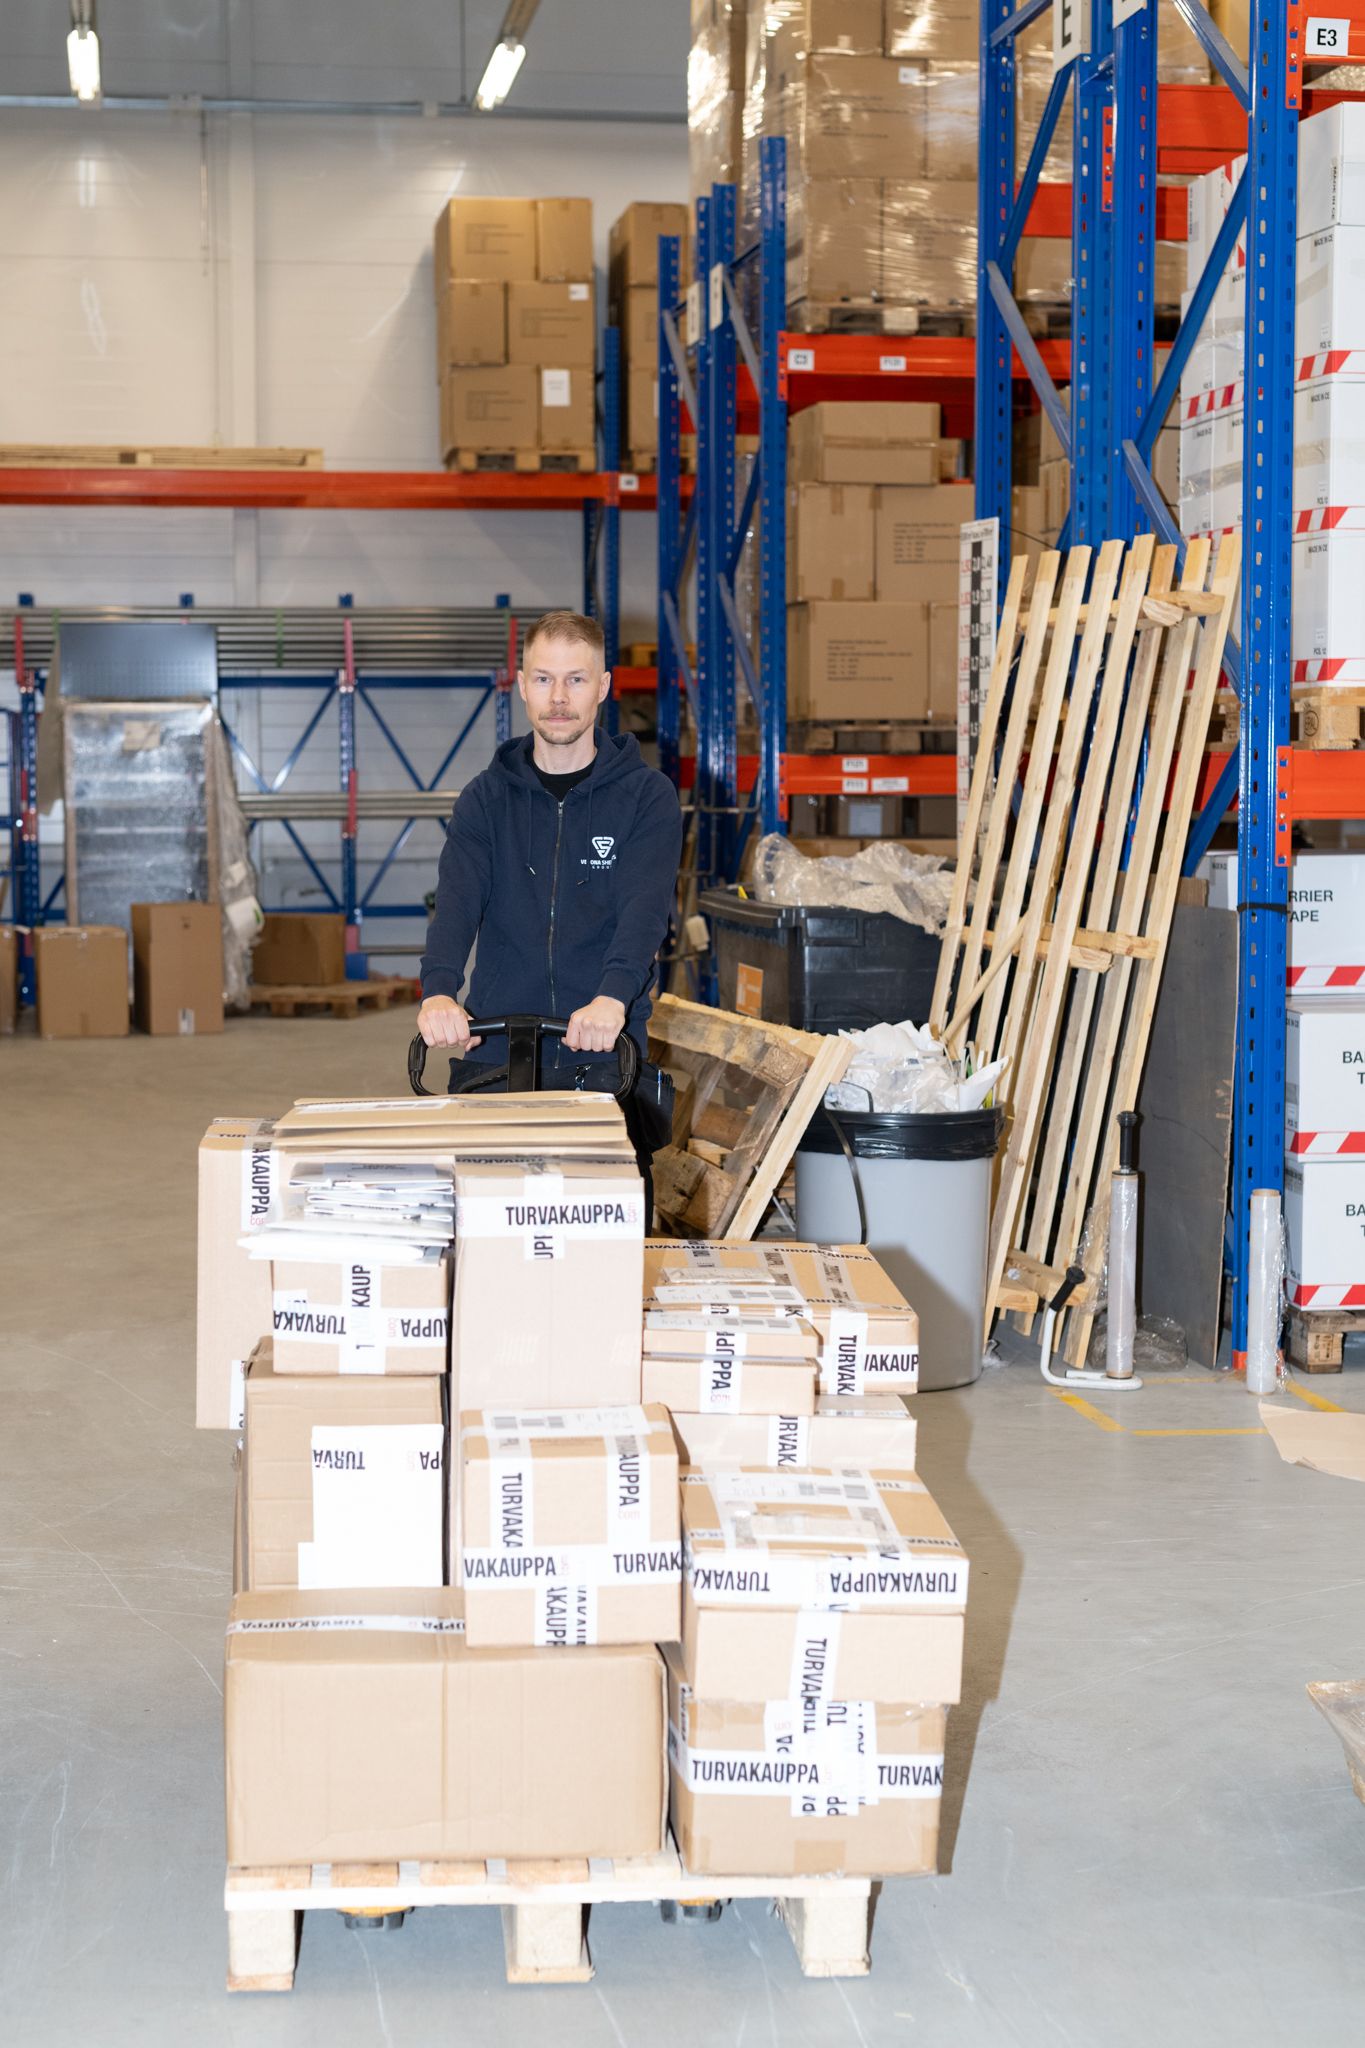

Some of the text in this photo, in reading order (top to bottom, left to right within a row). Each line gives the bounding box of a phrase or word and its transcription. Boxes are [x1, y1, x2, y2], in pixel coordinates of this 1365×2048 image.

[1316, 28, 1338, 47] E3
[1288, 910, 1319, 922] APE
[505, 1203, 625, 1226] TURVAKAUPPA
[420, 1451, 444, 1471] PA
[464, 1556, 556, 1578] VAKAUPPA
[692, 1759, 820, 1784] TURVAKAUPPA
